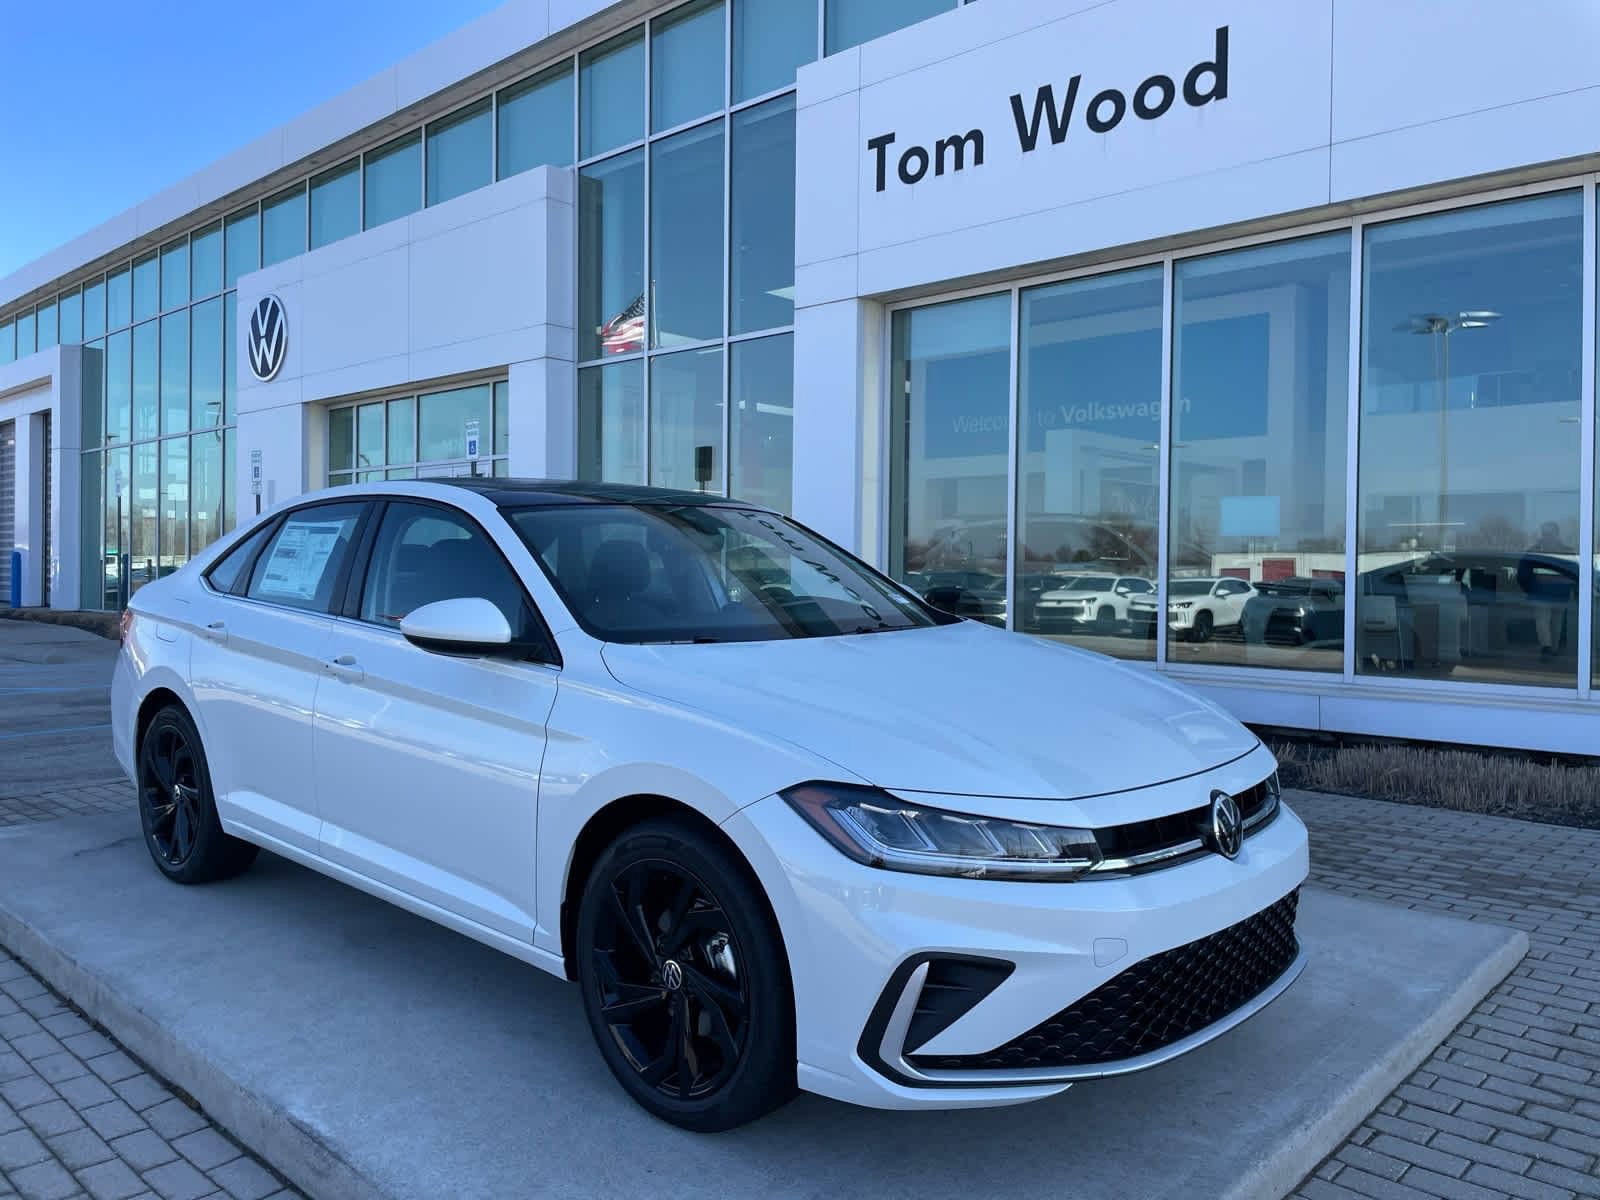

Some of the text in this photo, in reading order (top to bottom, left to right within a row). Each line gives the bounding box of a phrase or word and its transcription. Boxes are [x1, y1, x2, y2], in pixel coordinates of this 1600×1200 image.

[867, 25, 1230, 193] Tom Wood
[248, 294, 288, 382] VW
[952, 415, 1031, 433] Welco
[1060, 397, 1191, 425] Volkswagn
